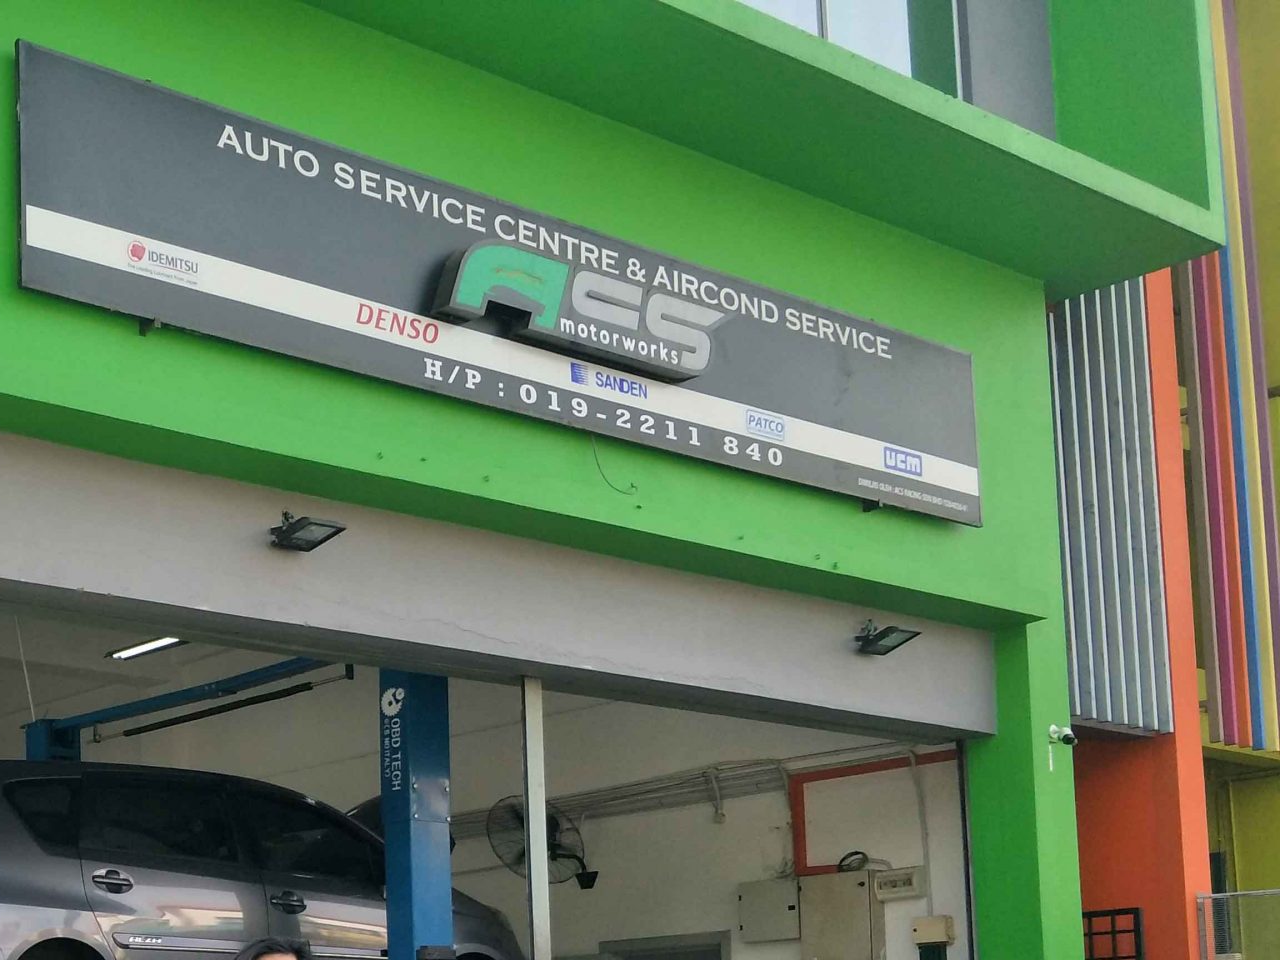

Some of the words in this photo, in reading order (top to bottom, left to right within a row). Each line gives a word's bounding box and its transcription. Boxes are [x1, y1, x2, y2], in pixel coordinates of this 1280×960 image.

[148, 250, 199, 273] IDEMITSU
[217, 125, 320, 177] AUTO
[334, 162, 486, 232] SERVICE
[494, 214, 619, 274] CENTRE
[627, 258, 646, 283] &
[652, 265, 779, 324] AIRCOND
[785, 308, 892, 359] SERVICE
[356, 303, 440, 344] DENSO
[560, 316, 680, 365] motorworks
[595, 371, 648, 399] SANDEN
[423, 357, 482, 390] H/P
[519, 384, 701, 446] 019-2211
[723, 436, 783, 466] 840
[748, 415, 784, 433] PATCO
[390, 718, 401, 748] OBD
[391, 751, 402, 790] TECH
